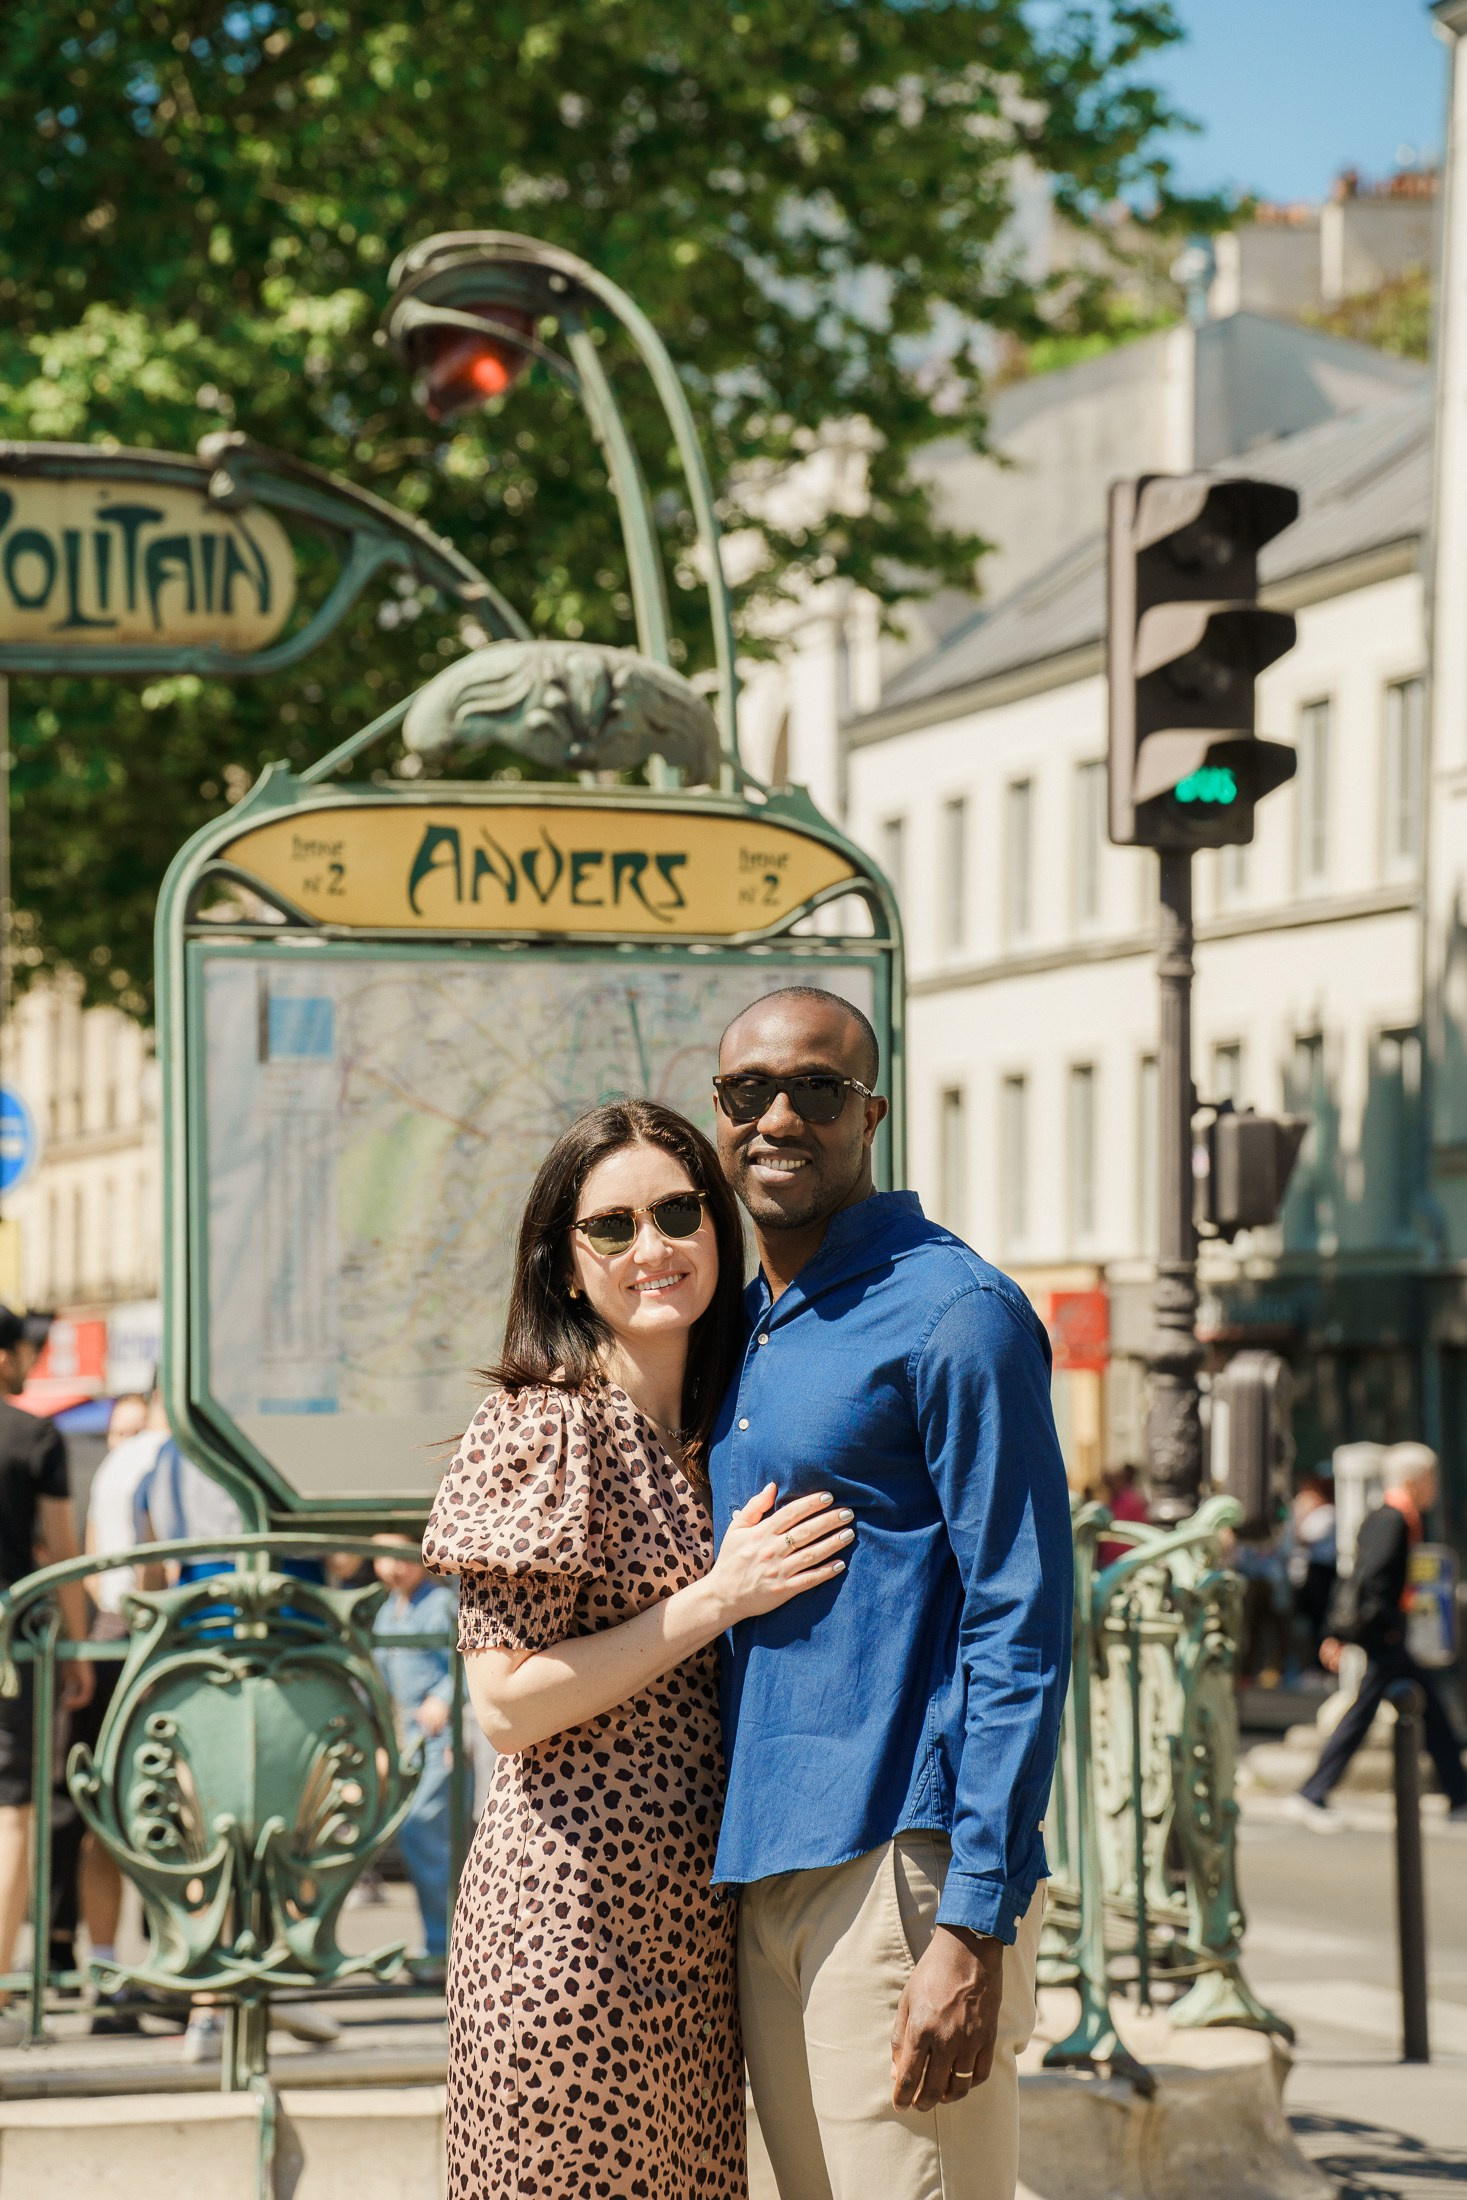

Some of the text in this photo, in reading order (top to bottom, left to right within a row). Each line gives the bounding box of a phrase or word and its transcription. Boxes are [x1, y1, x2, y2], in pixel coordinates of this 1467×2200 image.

[327, 863, 346, 896] 2
[408, 823, 687, 923] ANVERS
[762, 874, 780, 906] 2
